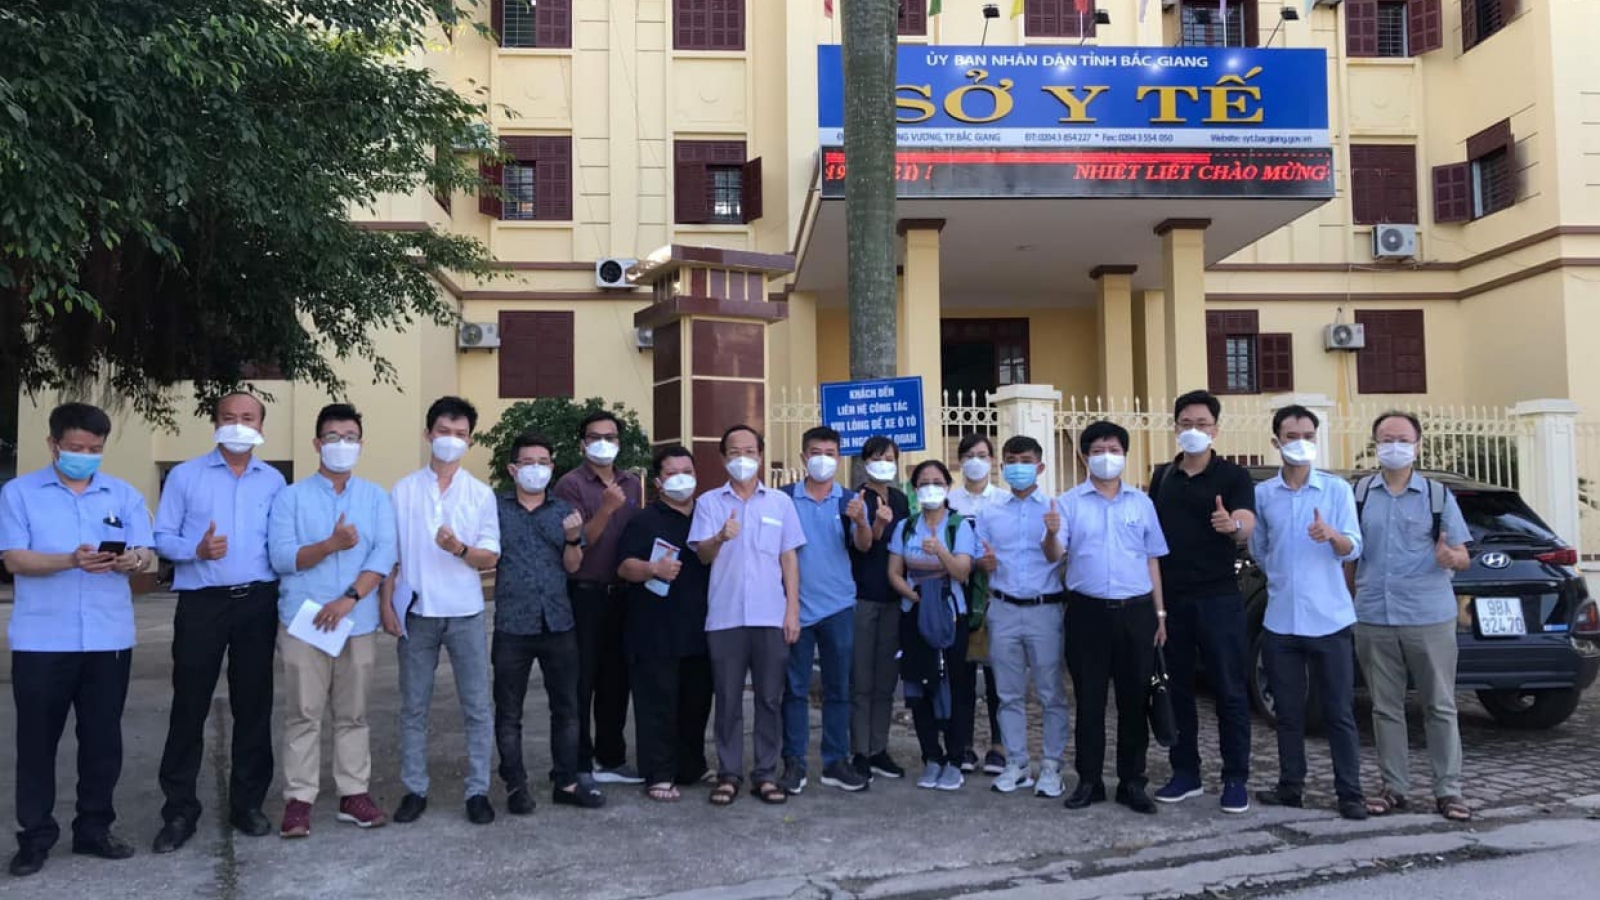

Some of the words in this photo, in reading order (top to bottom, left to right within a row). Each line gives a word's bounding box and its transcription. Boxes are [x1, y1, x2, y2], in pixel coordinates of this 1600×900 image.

[926, 51, 949, 66] ỦY
[954, 54, 987, 66] BAN
[991, 52, 1038, 66] NHÂN
[1042, 52, 1077, 67] DÂN
[1080, 51, 1117, 66] TỈNH
[1121, 51, 1153, 67] BẮC
[1157, 56, 1209, 68] GIANG
[896, 69, 1014, 124] SỞ
[1041, 85, 1110, 124] Y
[1136, 65, 1264, 124] TẾ
[974, 132, 1001, 142] GIANG
[1198, 161, 1258, 181] CHÀO
[1261, 161, 1328, 181] MỪNG
[885, 417, 896, 429] XE
